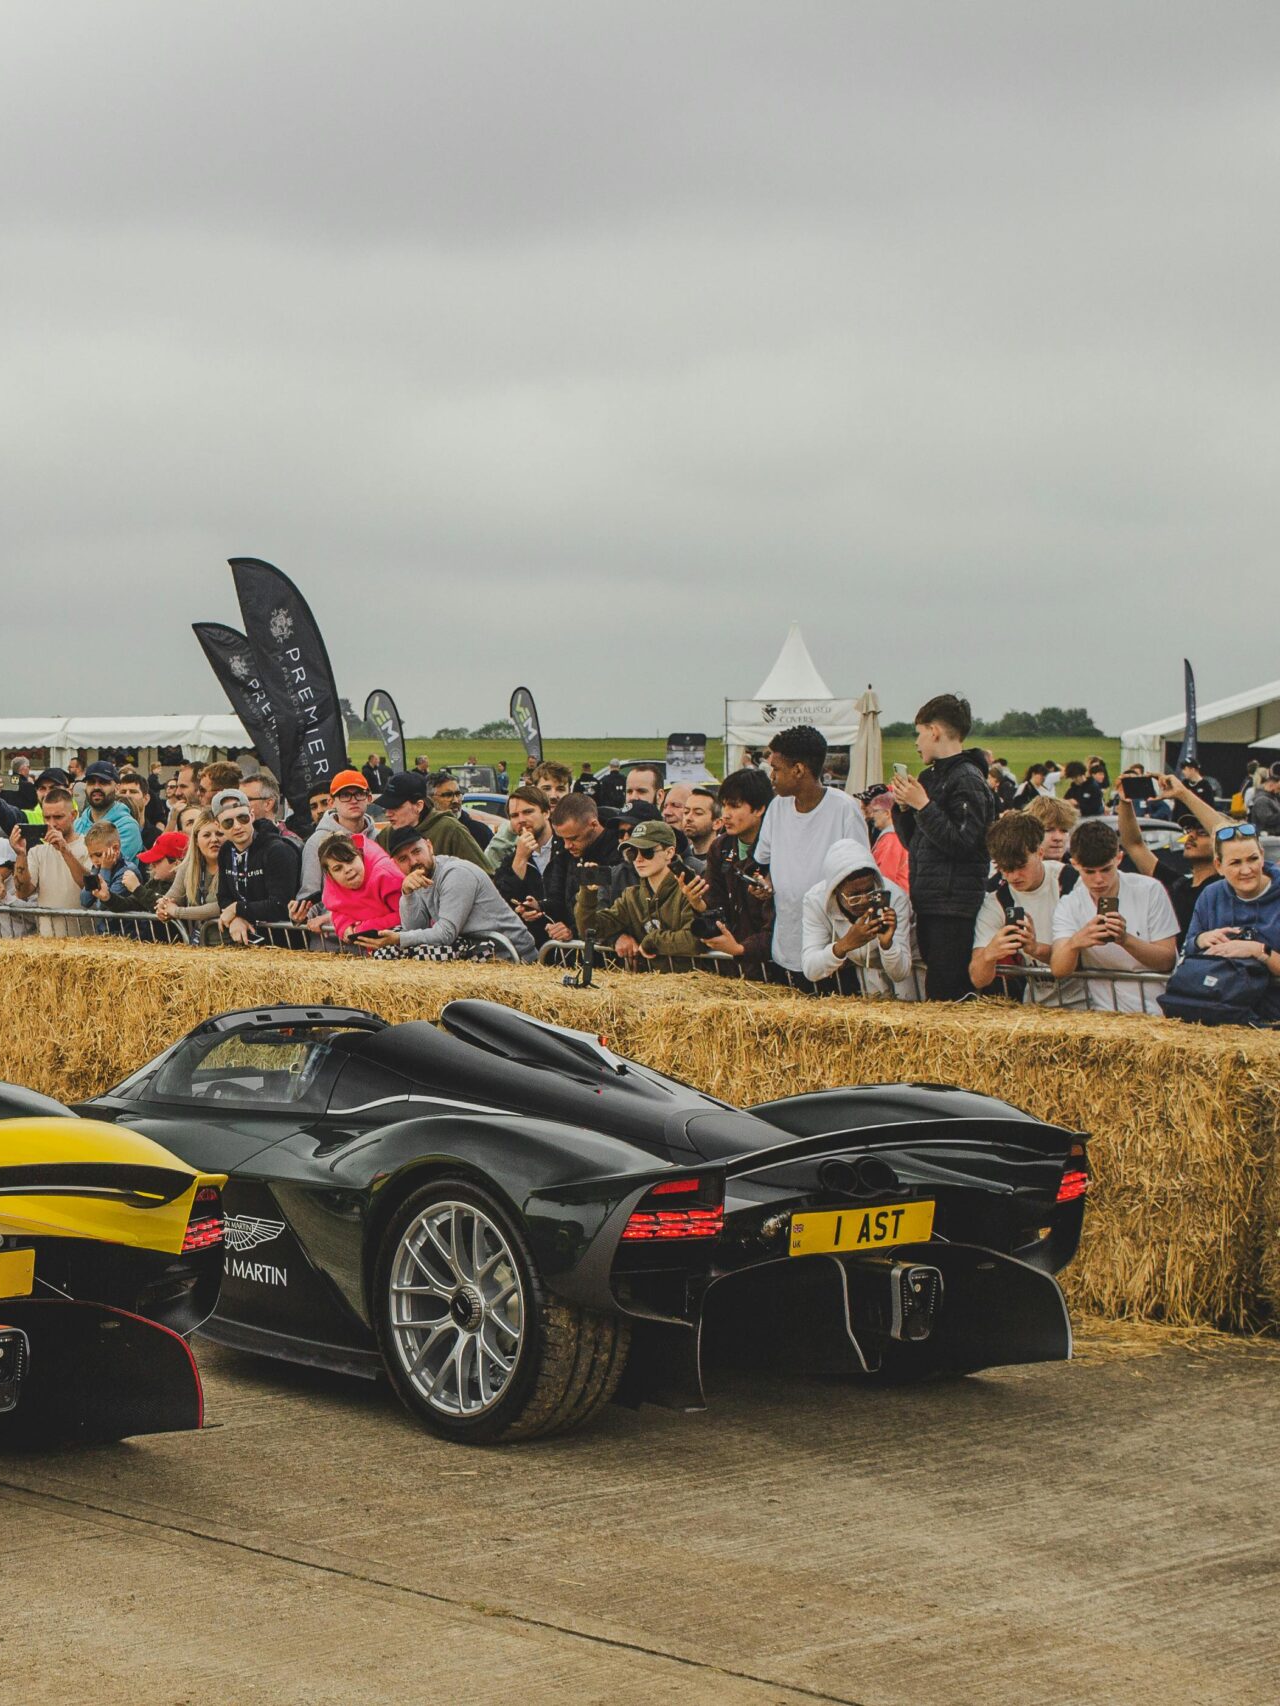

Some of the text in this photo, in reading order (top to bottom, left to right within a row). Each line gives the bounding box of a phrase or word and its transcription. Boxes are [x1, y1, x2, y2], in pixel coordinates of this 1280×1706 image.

[282, 667, 301, 715] PASSION
[286, 647, 329, 775] PREMIER
[779, 706, 831, 714] SPECIALISED
[780, 715, 814, 723] COVERS
[231, 1221, 252, 1231] MARTIN
[856, 1209, 905, 1245] AST
[792, 1240, 801, 1248] UK
[232, 1259, 287, 1287] MARTIN
